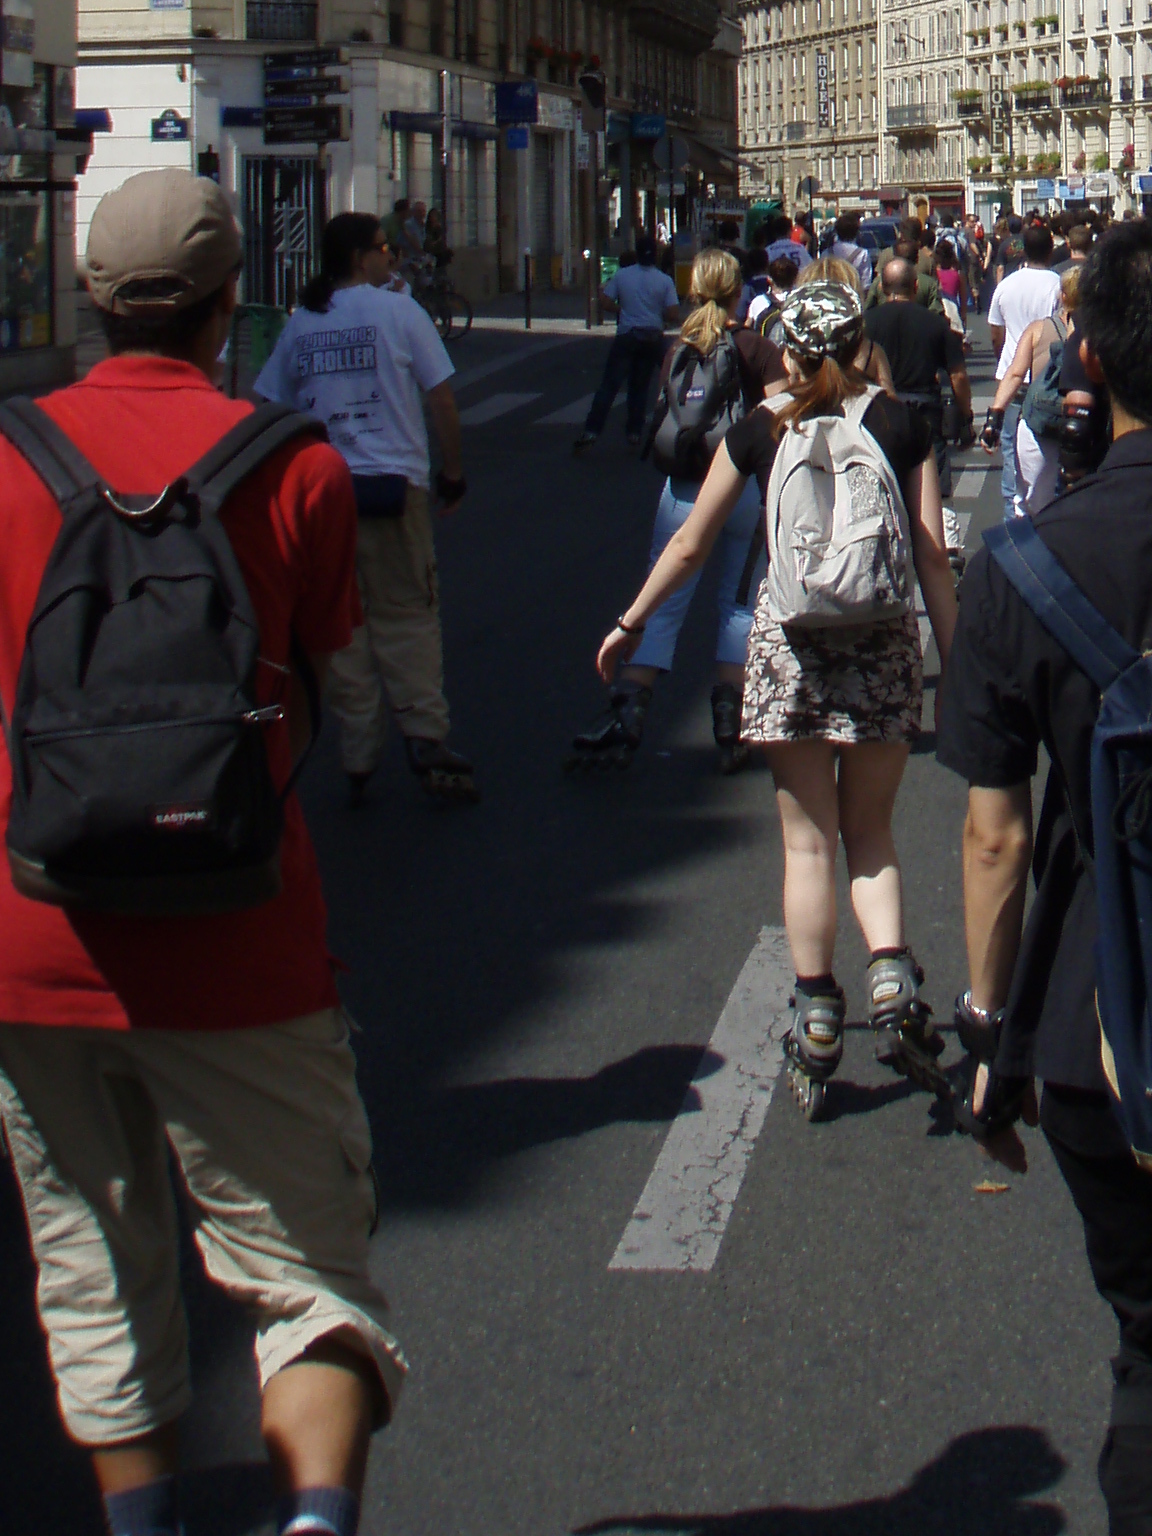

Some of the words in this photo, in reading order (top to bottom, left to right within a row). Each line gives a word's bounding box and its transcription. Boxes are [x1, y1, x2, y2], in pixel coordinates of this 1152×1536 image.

[818, 54, 828, 114] HOTEL
[991, 75, 1003, 148] HOTEL
[340, 326, 376, 344] 2003
[312, 345, 376, 375] ROLLER
[156, 810, 207, 825] EASTPAK
